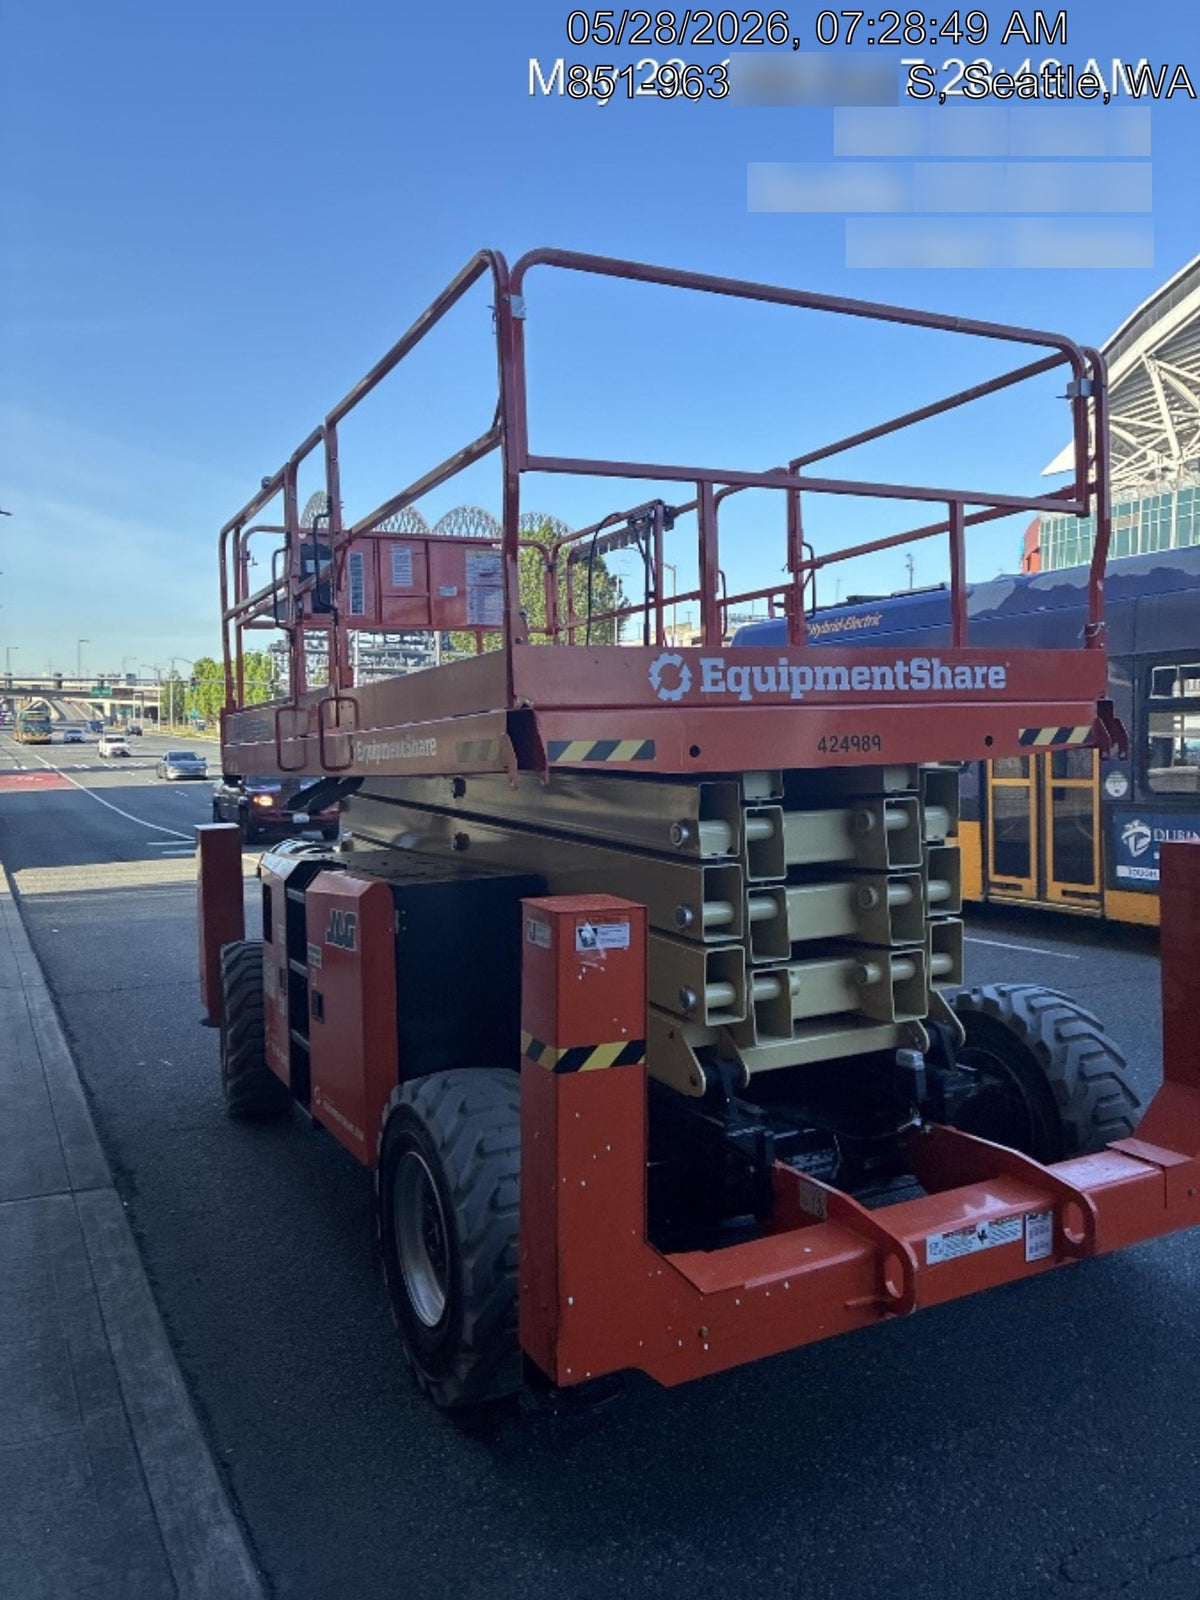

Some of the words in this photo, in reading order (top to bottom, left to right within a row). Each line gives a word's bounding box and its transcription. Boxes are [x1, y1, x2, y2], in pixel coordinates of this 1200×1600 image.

[700, 657, 1008, 701] EquipmentShare
[817, 735, 882, 753] 424989
[325, 908, 358, 952] JLG
